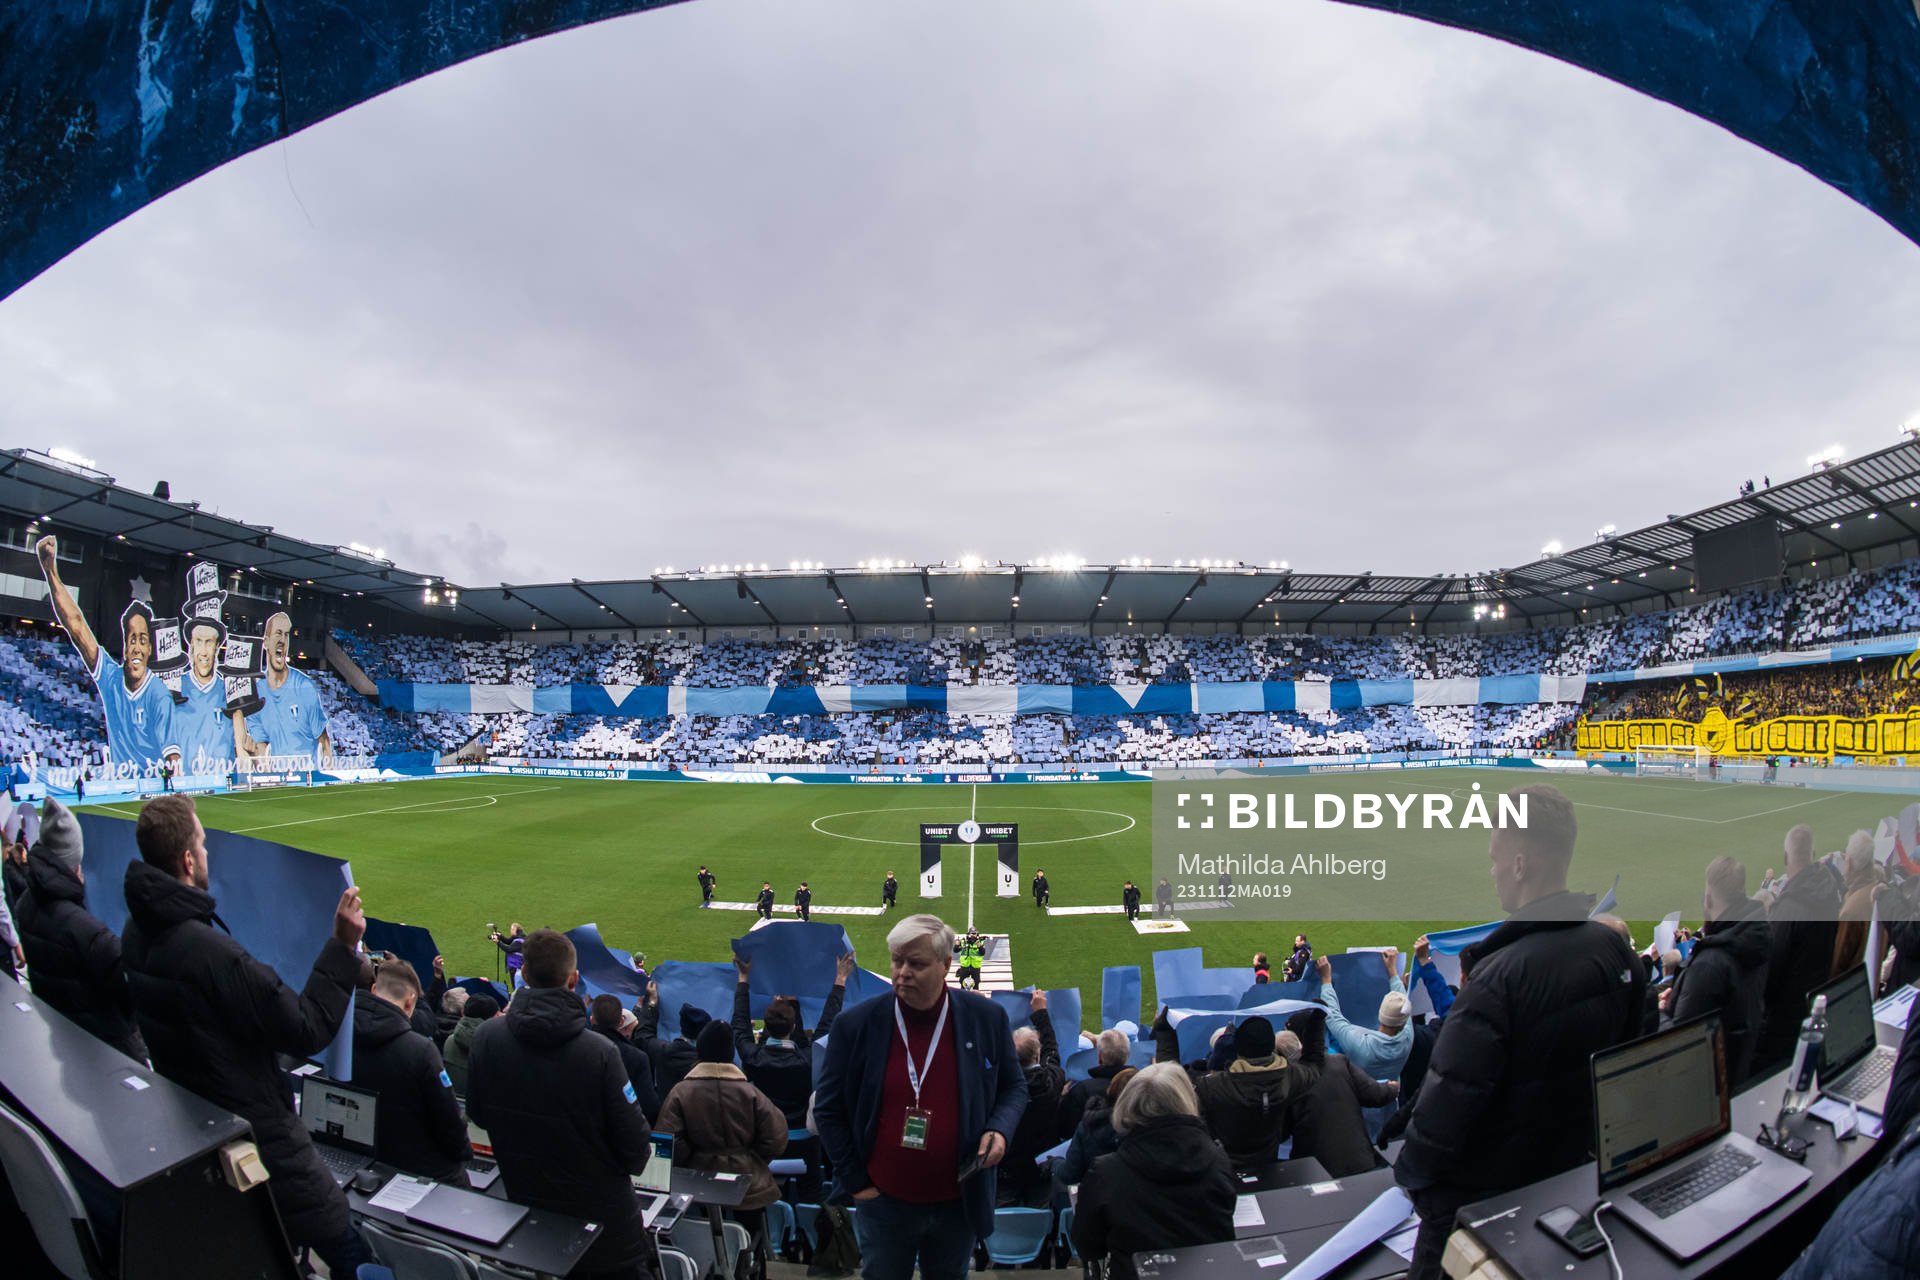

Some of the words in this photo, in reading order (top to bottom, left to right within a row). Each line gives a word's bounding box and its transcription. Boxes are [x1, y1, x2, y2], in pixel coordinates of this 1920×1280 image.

[511, 766, 533, 775] SWISHA
[534, 767, 548, 776] DITT
[570, 769, 582, 777] TILL
[925, 827, 953, 835] UNIBET
[985, 827, 1013, 835] UNIBET
